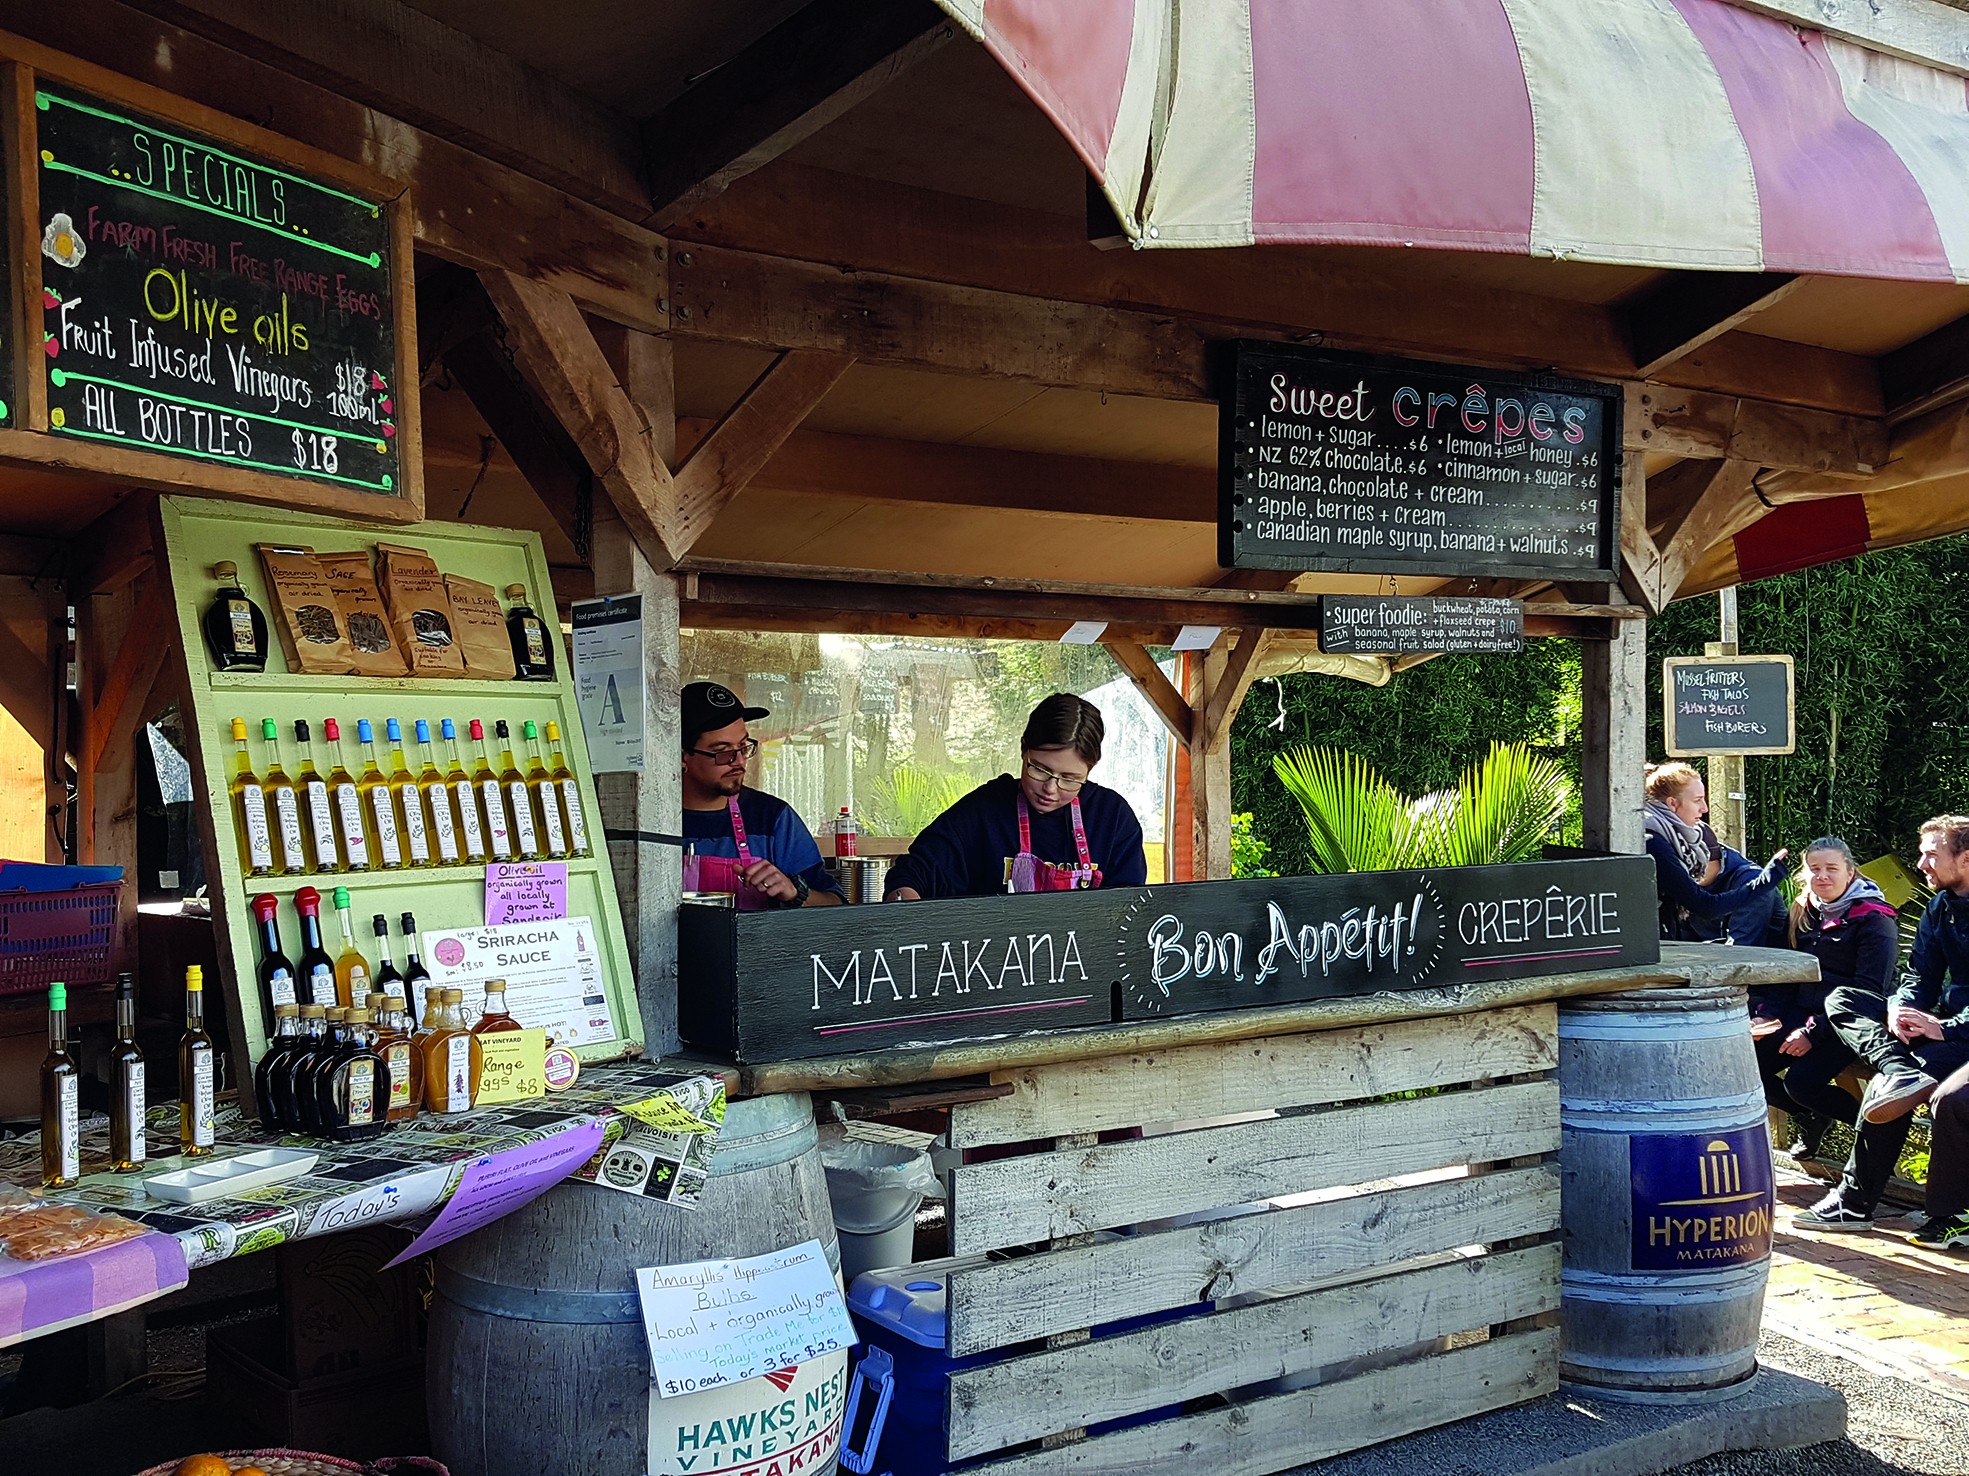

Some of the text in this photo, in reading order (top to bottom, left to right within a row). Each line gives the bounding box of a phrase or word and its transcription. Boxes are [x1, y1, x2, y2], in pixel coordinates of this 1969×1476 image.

[88, 205, 381, 321] FARM FRESH FREE RANGE EGGS
[144, 268, 309, 356] Olive oils
[226, 344, 312, 414] Vinegars
[1270, 372, 1586, 445] Sweet crêpes
[86, 384, 339, 471] ALL BOTTLES $18
[1262, 414, 1311, 440] lemon
[1329, 426, 1376, 449] sugar
[1259, 446, 1281, 463] NZ
[1290, 446, 1322, 468] 62%
[1446, 433, 1491, 457] lemon
[1504, 440, 1526, 455] local
[1530, 442, 1573, 468] honey
[1445, 458, 1520, 483] cinnamon
[1535, 470, 1576, 489] sugar
[1430, 486, 1483, 506] cream
[1258, 496, 1312, 521] apple,
[1317, 498, 1374, 521] berries
[1394, 506, 1446, 526] cream
[1257, 521, 1329, 544] canadian
[1337, 526, 1383, 549] maple
[1389, 529, 1437, 554] syrup,
[1440, 530, 1495, 551] banana
[1510, 535, 1568, 554] walnuts
[271, 566, 318, 579] Rosemary
[325, 568, 356, 580] SAGE
[390, 563, 437, 576] Lavender
[453, 595, 467, 604] BAY
[1503, 606, 1520, 615] corn
[1334, 602, 1427, 628] super foodie:
[1326, 629, 1348, 642] with
[1354, 639, 1396, 650] seasonal
[1399, 637, 1420, 652] fruit
[1423, 639, 1445, 650] salad
[1392, 626, 1417, 639] maple
[1448, 626, 1481, 638] walnuts
[1482, 627, 1495, 637] and
[598, 673, 627, 727] A
[1701, 688, 1750, 701] FISH TACOS
[1706, 720, 1724, 732] FISH
[487, 879, 562, 893] organically grown
[500, 890, 550, 903] all locally
[507, 901, 555, 916] grown at
[1459, 886, 1621, 946] CREPÊRIE
[477, 931, 560, 949] SRIRACHA
[1148, 893, 1422, 996] Bon Appétit!
[496, 950, 552, 967] SAUCE
[811, 931, 1088, 1011] MATAKANA
[483, 1056, 525, 1076] Range
[516, 1078, 538, 1095] $8
[320, 1194, 401, 1230] Today's
[1649, 1203, 1769, 1246] HYPERION
[1677, 1242, 1754, 1260] MATAKANA
[653, 1268, 725, 1291] Amaryllis
[655, 1316, 700, 1341] Local
[727, 1292, 812, 1331] organically
[665, 1378, 697, 1396] $10
[740, 1367, 755, 1379] or
[764, 1358, 778, 1371] 3
[780, 1351, 800, 1367] for
[677, 1364, 844, 1453] HAWKS NEST
[676, 1395, 843, 1471] VINEYARD
